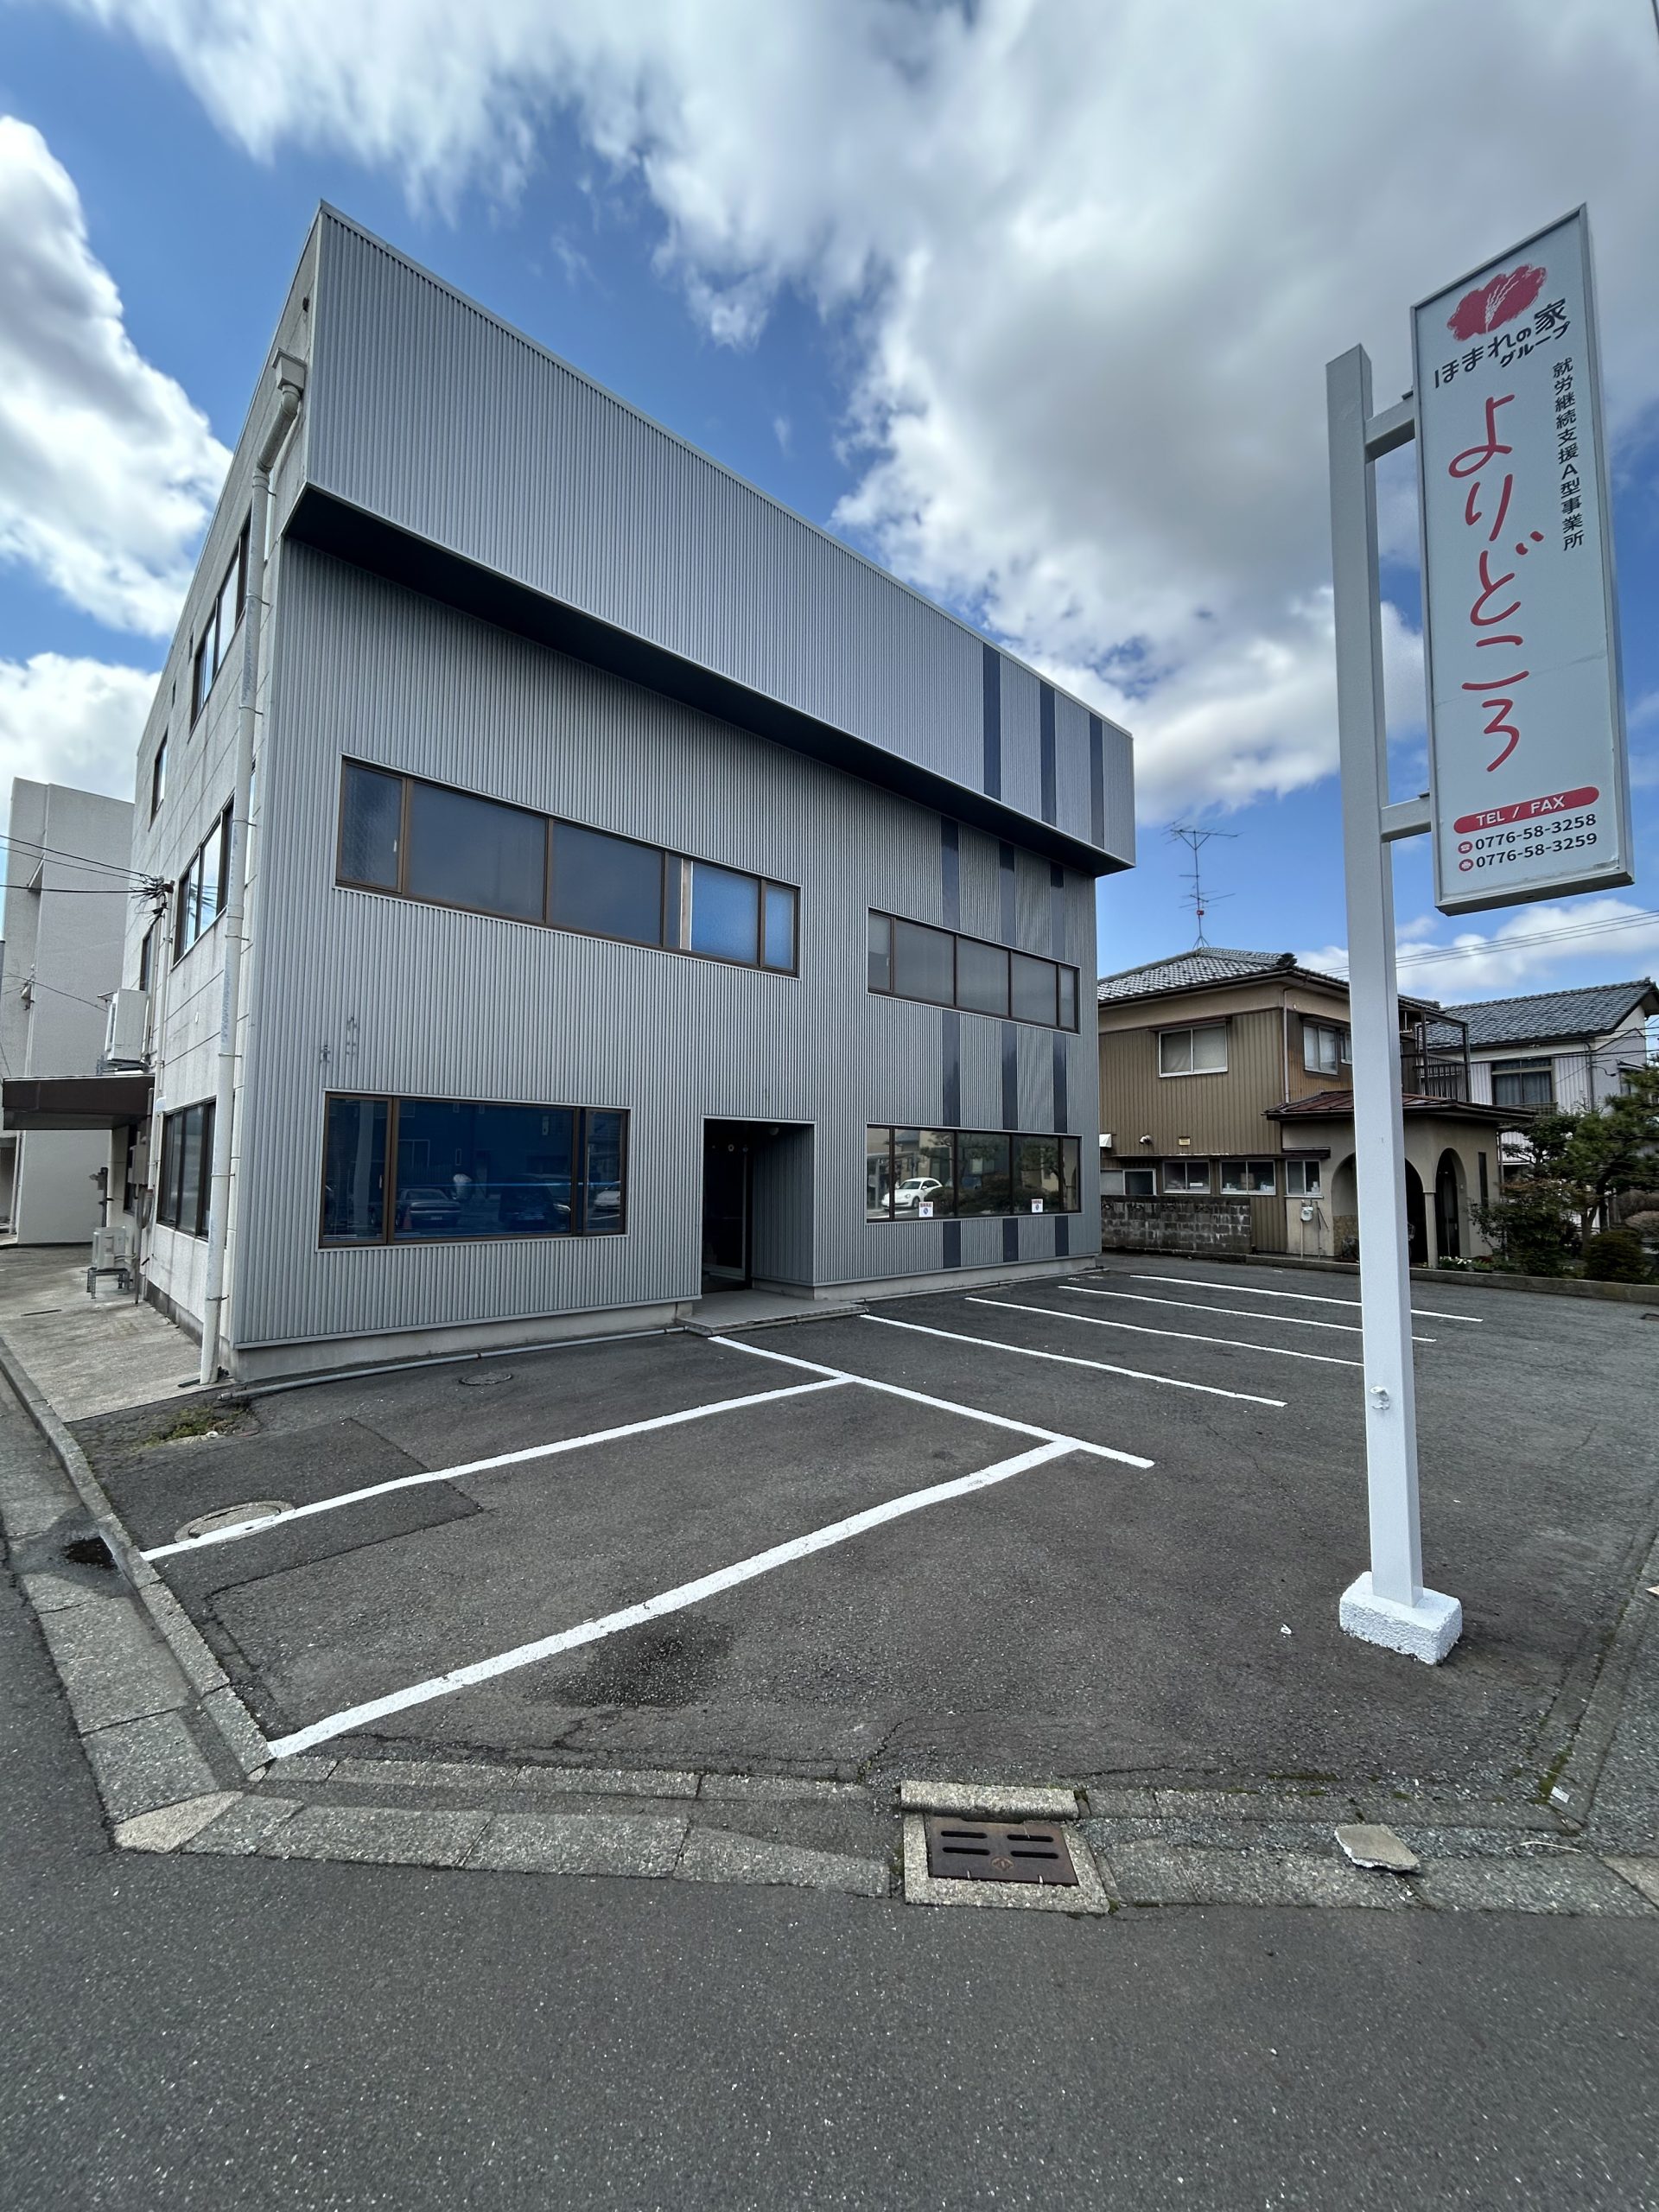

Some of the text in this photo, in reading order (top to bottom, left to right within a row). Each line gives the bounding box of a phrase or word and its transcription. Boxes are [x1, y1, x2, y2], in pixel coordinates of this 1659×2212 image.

[1434, 298, 1567, 389] ほまれの家
[1499, 321, 1572, 368] グループ
[1552, 357, 1585, 551] 就労継続支援A型事業所
[1447, 394, 1545, 773] よりどころ
[1475, 813, 1597, 850] 0776-58-3258
[1476, 810, 1505, 827] TEL
[1530, 795, 1566, 815] FAX
[1476, 832, 1598, 868] 0776-58-3259
